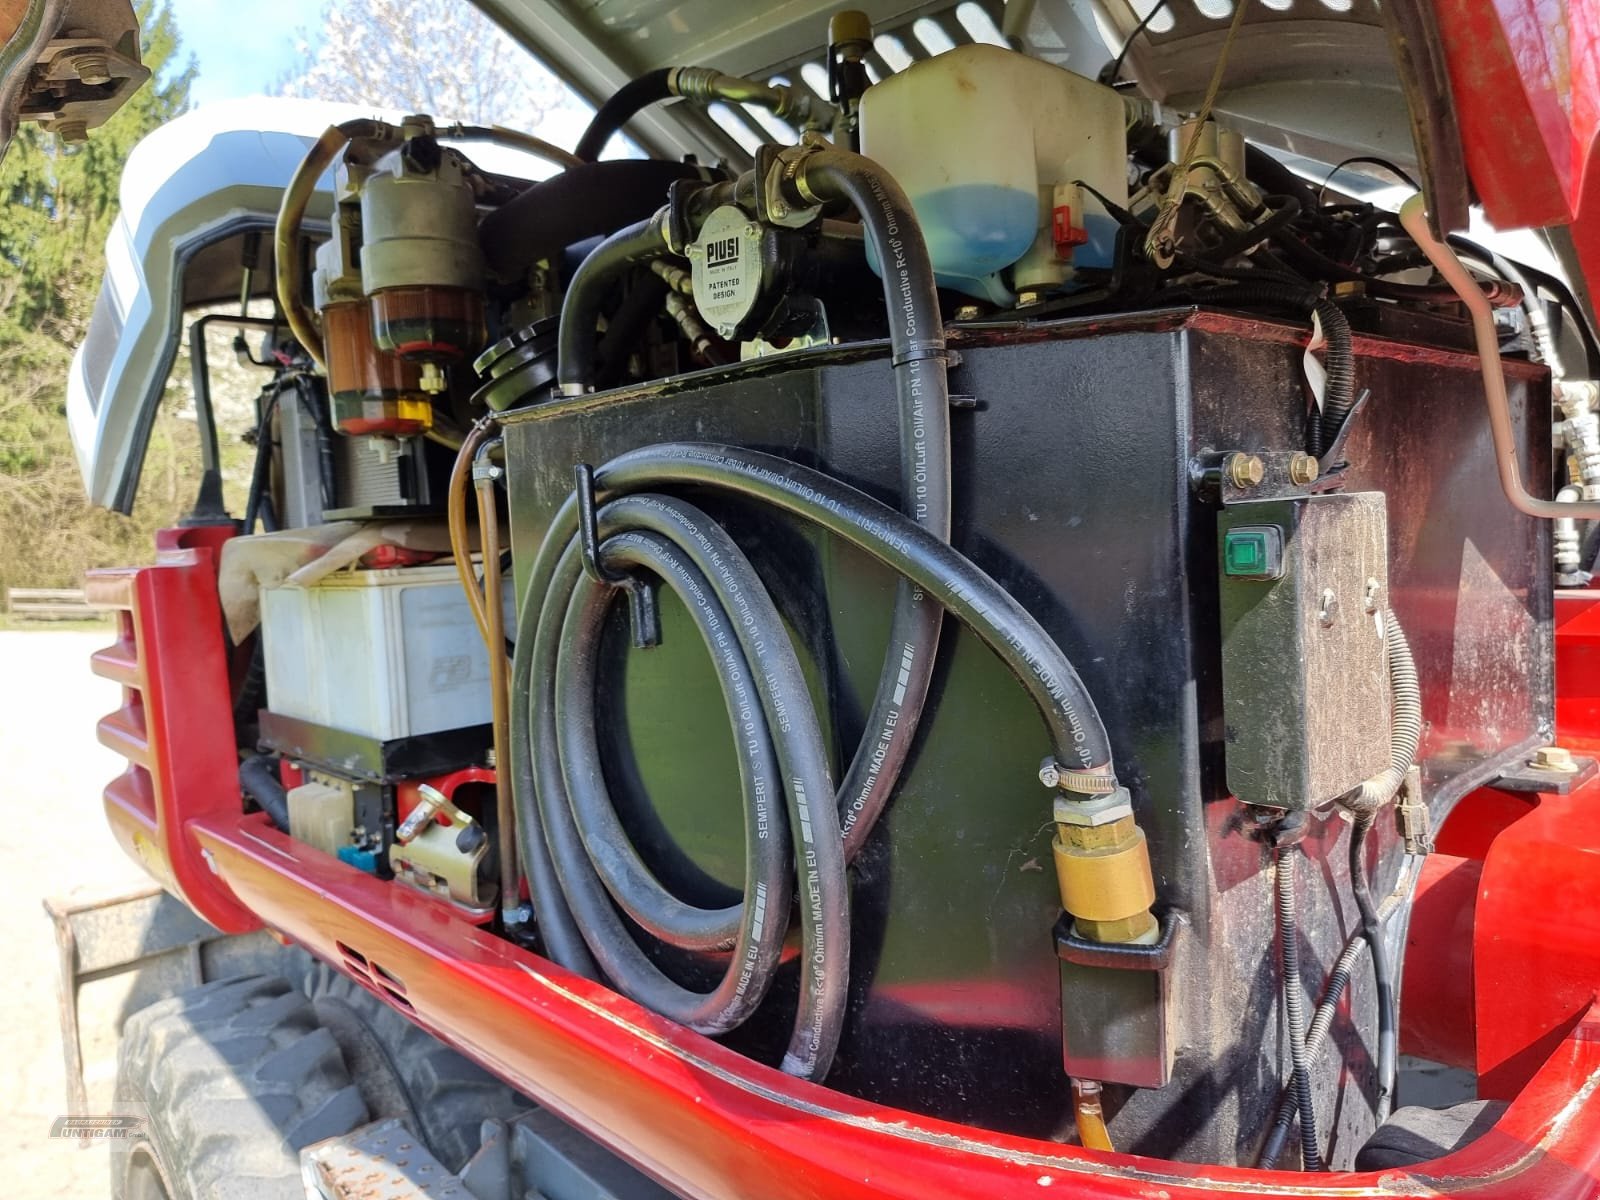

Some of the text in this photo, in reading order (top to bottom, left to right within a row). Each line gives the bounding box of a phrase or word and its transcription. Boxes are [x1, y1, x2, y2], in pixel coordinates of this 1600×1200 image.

[706, 237, 739, 262] PIUSI
[708, 278, 740, 290] PATENTED
[713, 290, 736, 300] DESIGN
[898, 269, 918, 337] Conductive
[911, 378, 922, 397] PN
[912, 400, 926, 438] Oil/Air
[745, 463, 759, 475] PN
[815, 492, 827, 505] 10
[916, 485, 927, 499] 10
[827, 498, 841, 514] TU
[917, 503, 928, 520] TU
[855, 516, 911, 555] SEMPERIT
[710, 555, 722, 567] PN
[676, 566, 707, 606] Conductive
[715, 631, 729, 648] PN
[749, 626, 761, 640] 10
[1007, 631, 1022, 651] EU
[753, 640, 767, 657] TU
[1022, 650, 1035, 665] IN
[1032, 662, 1064, 700] MADE
[766, 672, 791, 733] SEMPERIT
[885, 710, 899, 728] EU
[1061, 697, 1087, 743] Ohm/m
[745, 722, 755, 737] 10
[881, 728, 894, 743] IN
[748, 740, 759, 757] TU
[868, 743, 889, 775] MADE
[853, 775, 877, 811] Ohm/m
[754, 776, 769, 839] SEMPERIT
[806, 850, 817, 868] EU
[808, 871, 819, 884] IN
[810, 886, 824, 923] MADE
[813, 924, 826, 963] Ohm/m
[735, 945, 759, 996] MADE IN EU
[809, 997, 825, 1051] Conductive
